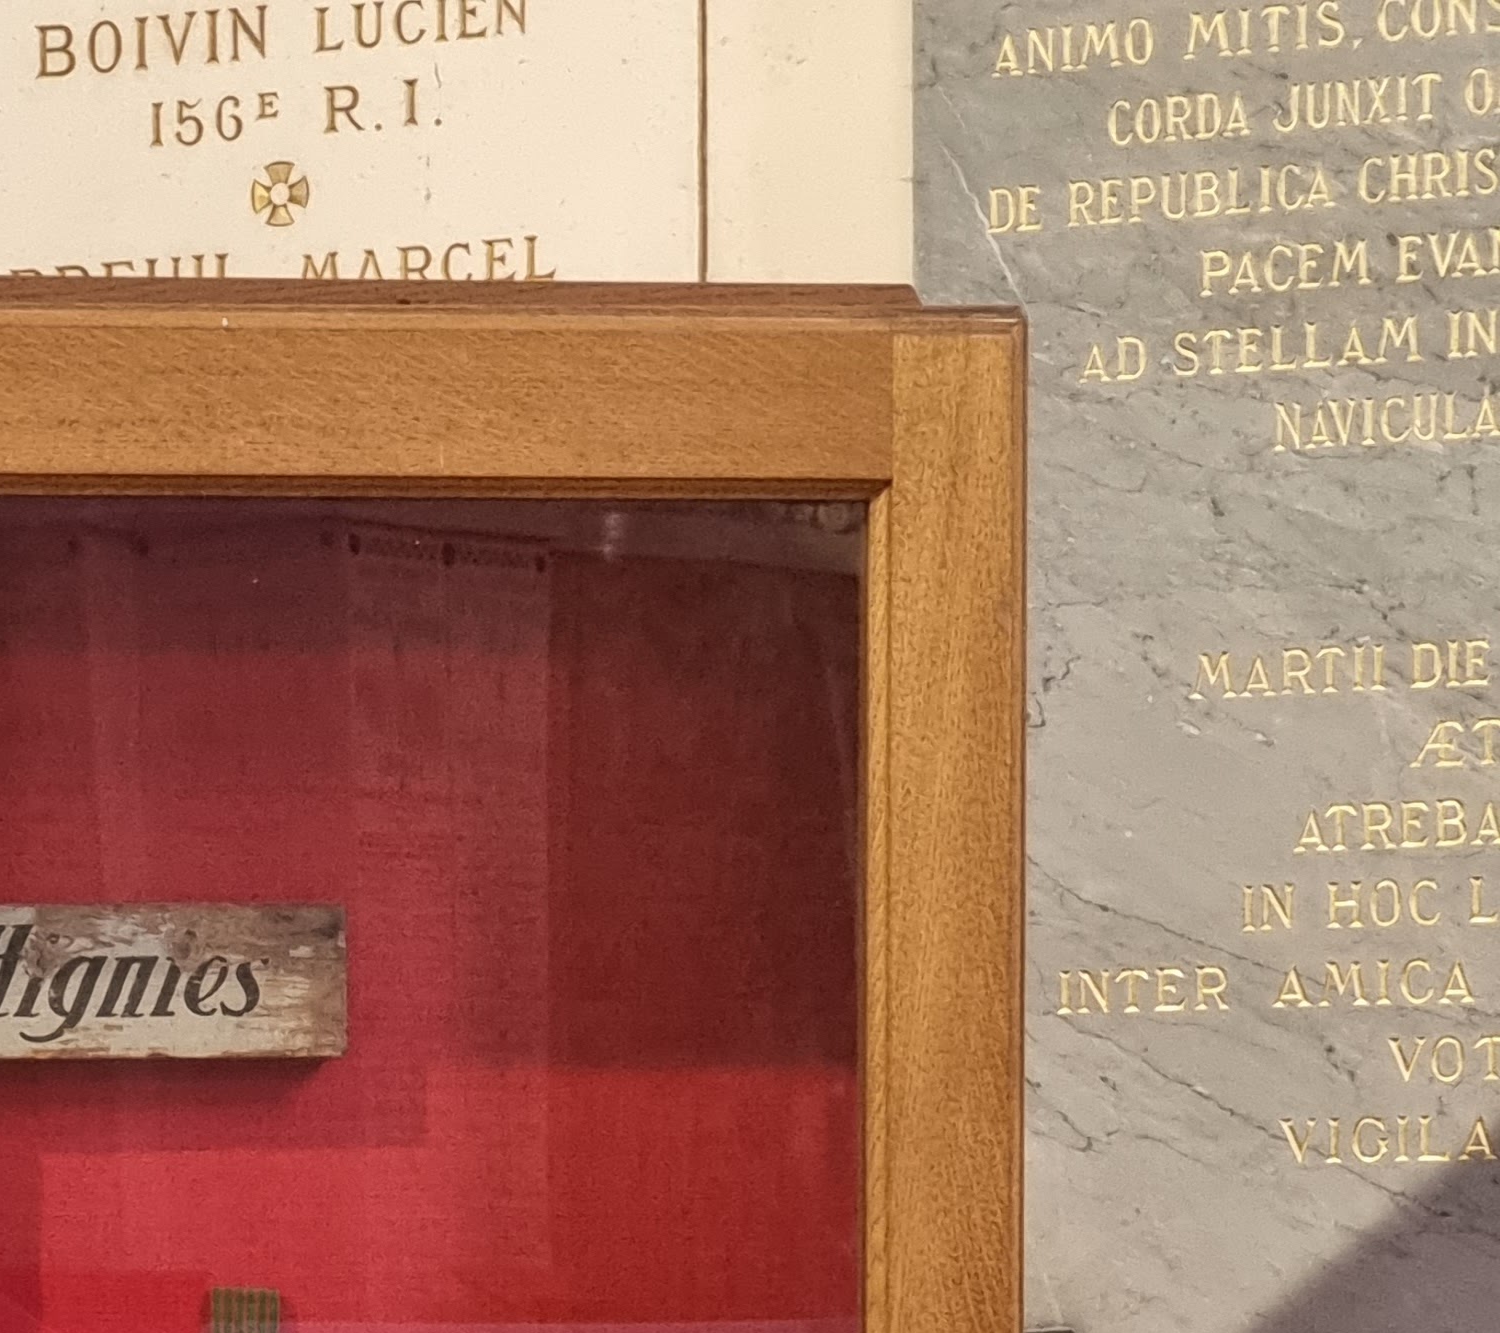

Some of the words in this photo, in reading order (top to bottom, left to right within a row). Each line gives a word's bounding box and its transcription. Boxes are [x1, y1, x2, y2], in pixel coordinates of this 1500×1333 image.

[35, 5, 268, 79] BOIVIN
[314, 0, 527, 53] LUCIEN
[991, 17, 1154, 78] ANIMO
[1183, 0, 1364, 60] MITIS,
[1107, 92, 1251, 145] CORDA
[1272, 72, 1443, 132] JUNXIT
[988, 186, 1042, 233] DE
[1067, 162, 1337, 228] REPUBLICA
[1357, 148, 1499, 204] CHRIS
[301, 235, 557, 281] MARCEL
[1200, 238, 1372, 297] PACEM
[1080, 336, 1147, 384] AD
[1173, 313, 1424, 376] STELLAM
[1274, 388, 1500, 451] NAVICULA
[1188, 643, 1388, 699] MARTII
[1409, 640, 1491, 689] DIE
[1242, 882, 1295, 932] IN
[1326, 878, 1441, 929] HOC
[1057, 966, 1230, 1015] INTER
[1272, 958, 1476, 1008] AMICA
[1279, 1114, 1498, 1164] VIGILA
